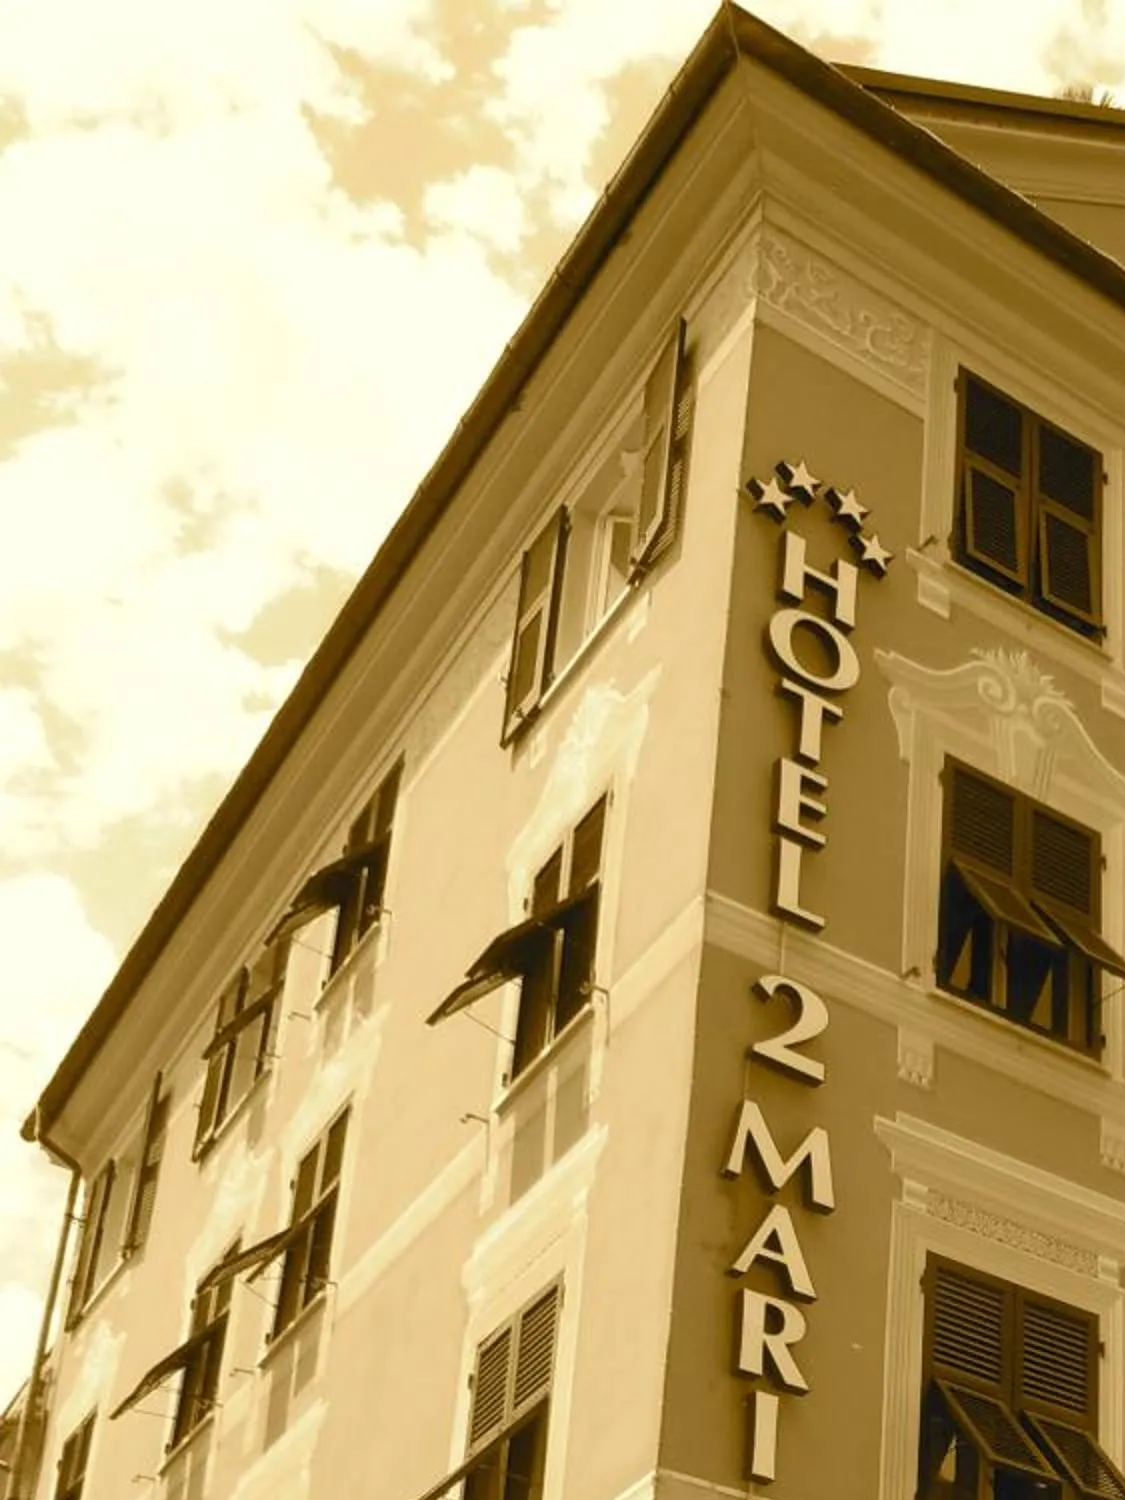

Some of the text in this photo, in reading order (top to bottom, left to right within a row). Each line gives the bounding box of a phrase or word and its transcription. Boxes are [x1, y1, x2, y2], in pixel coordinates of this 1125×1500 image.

[723, 531, 860, 1482] HOTEL 2 MARI
